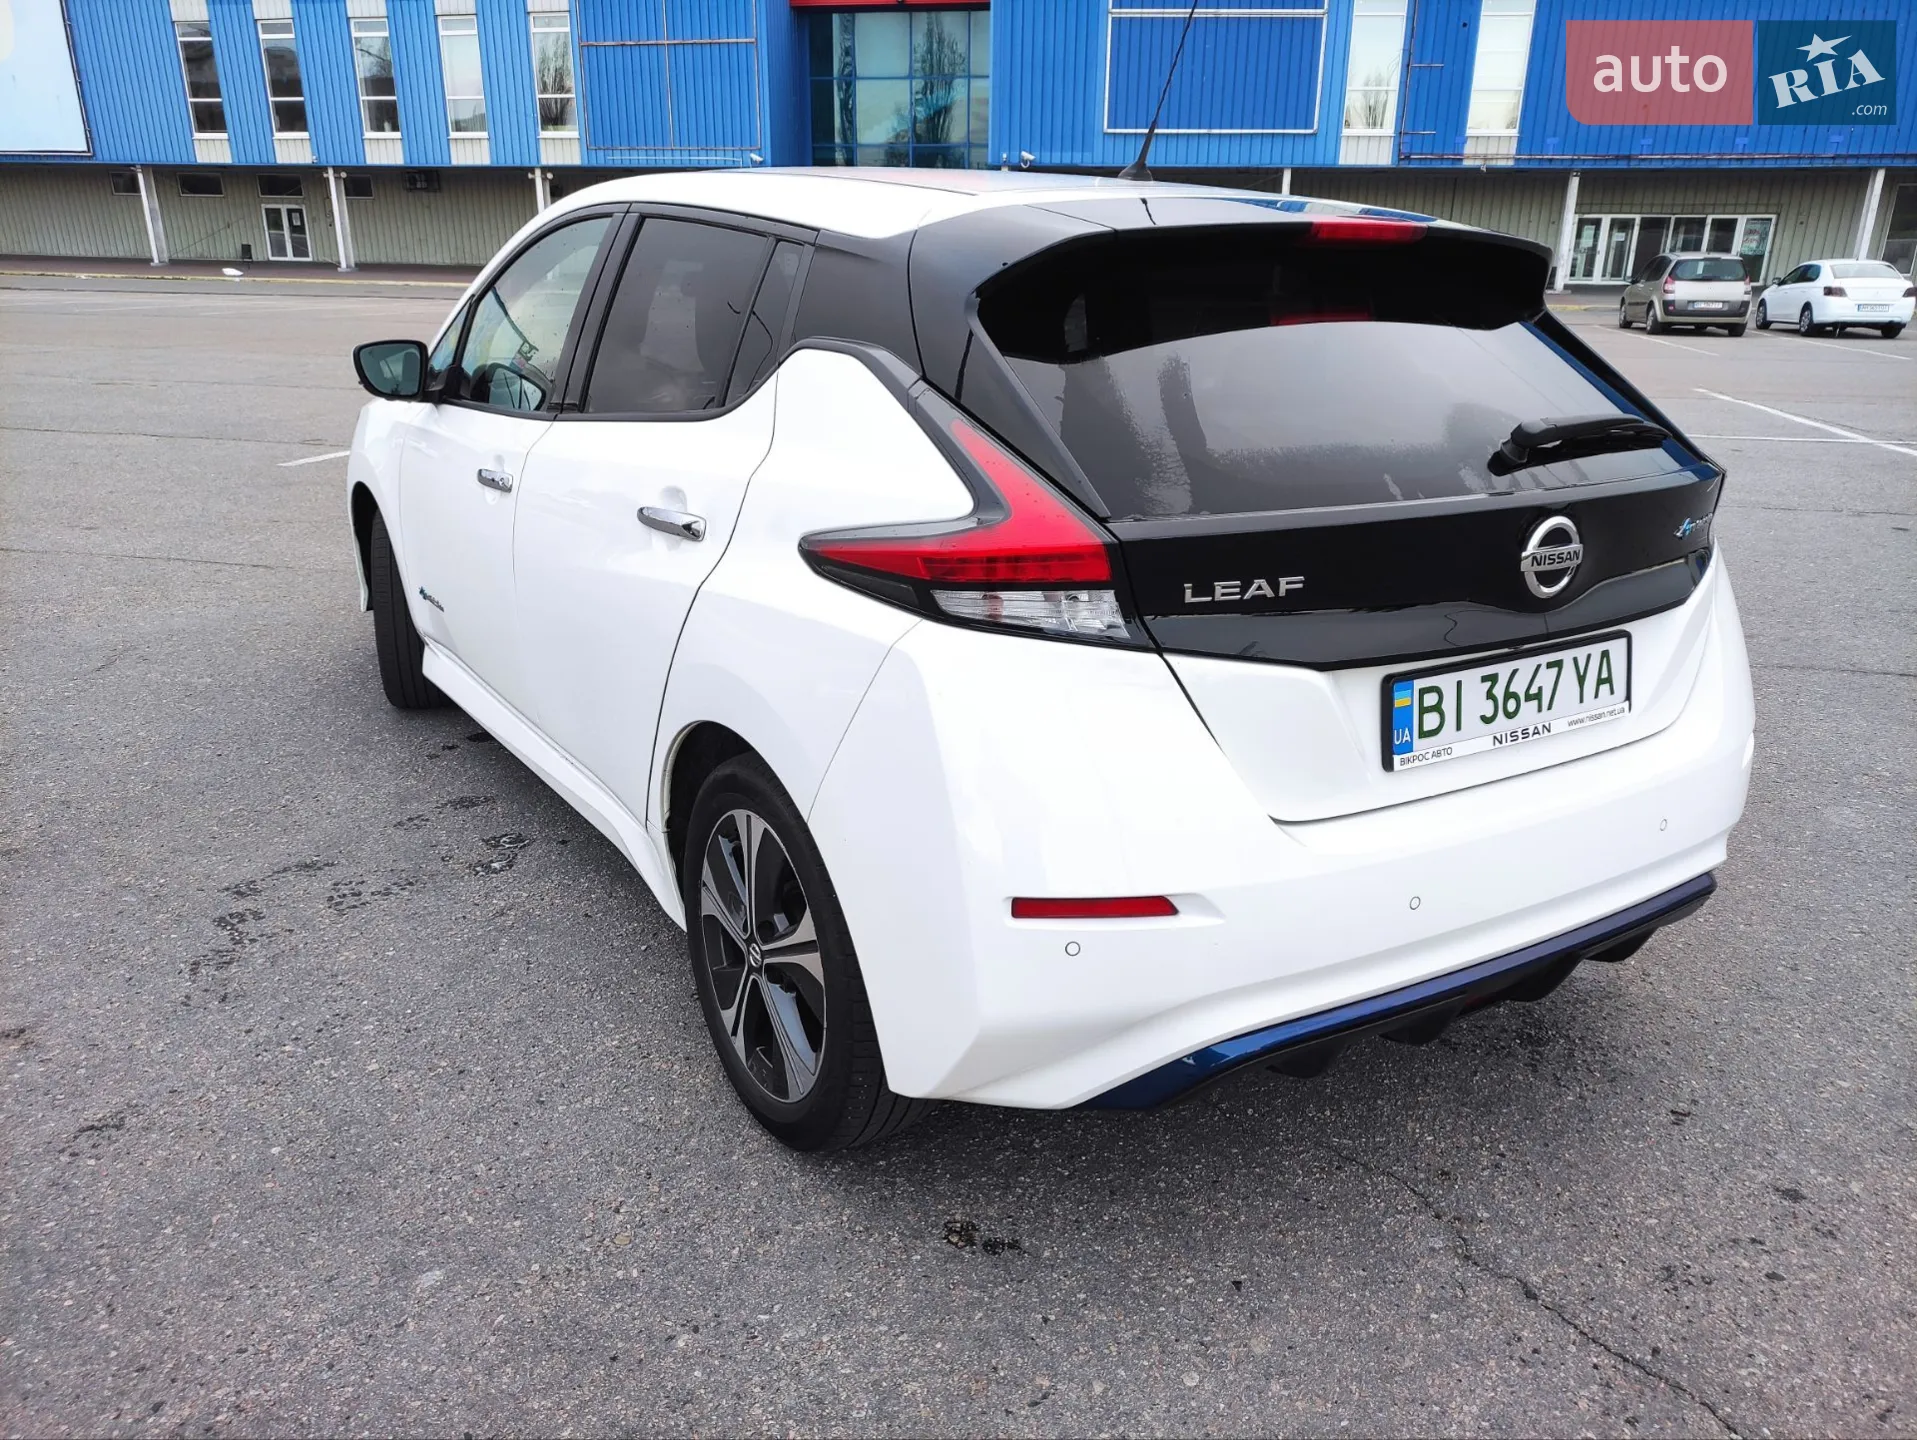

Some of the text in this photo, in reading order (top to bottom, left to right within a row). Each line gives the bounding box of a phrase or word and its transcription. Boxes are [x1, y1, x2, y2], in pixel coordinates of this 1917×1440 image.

[1531, 549, 1580, 567] NISSAN
[1184, 576, 1305, 603] LEAF
[1418, 649, 1615, 740] BI 3647 YA
[1567, 706, 1626, 727] www.nissan.net.ua
[1394, 727, 1411, 745] UA
[1493, 722, 1552, 746] NISSAN
[1400, 746, 1453, 767] ВІКРОС АВТО
